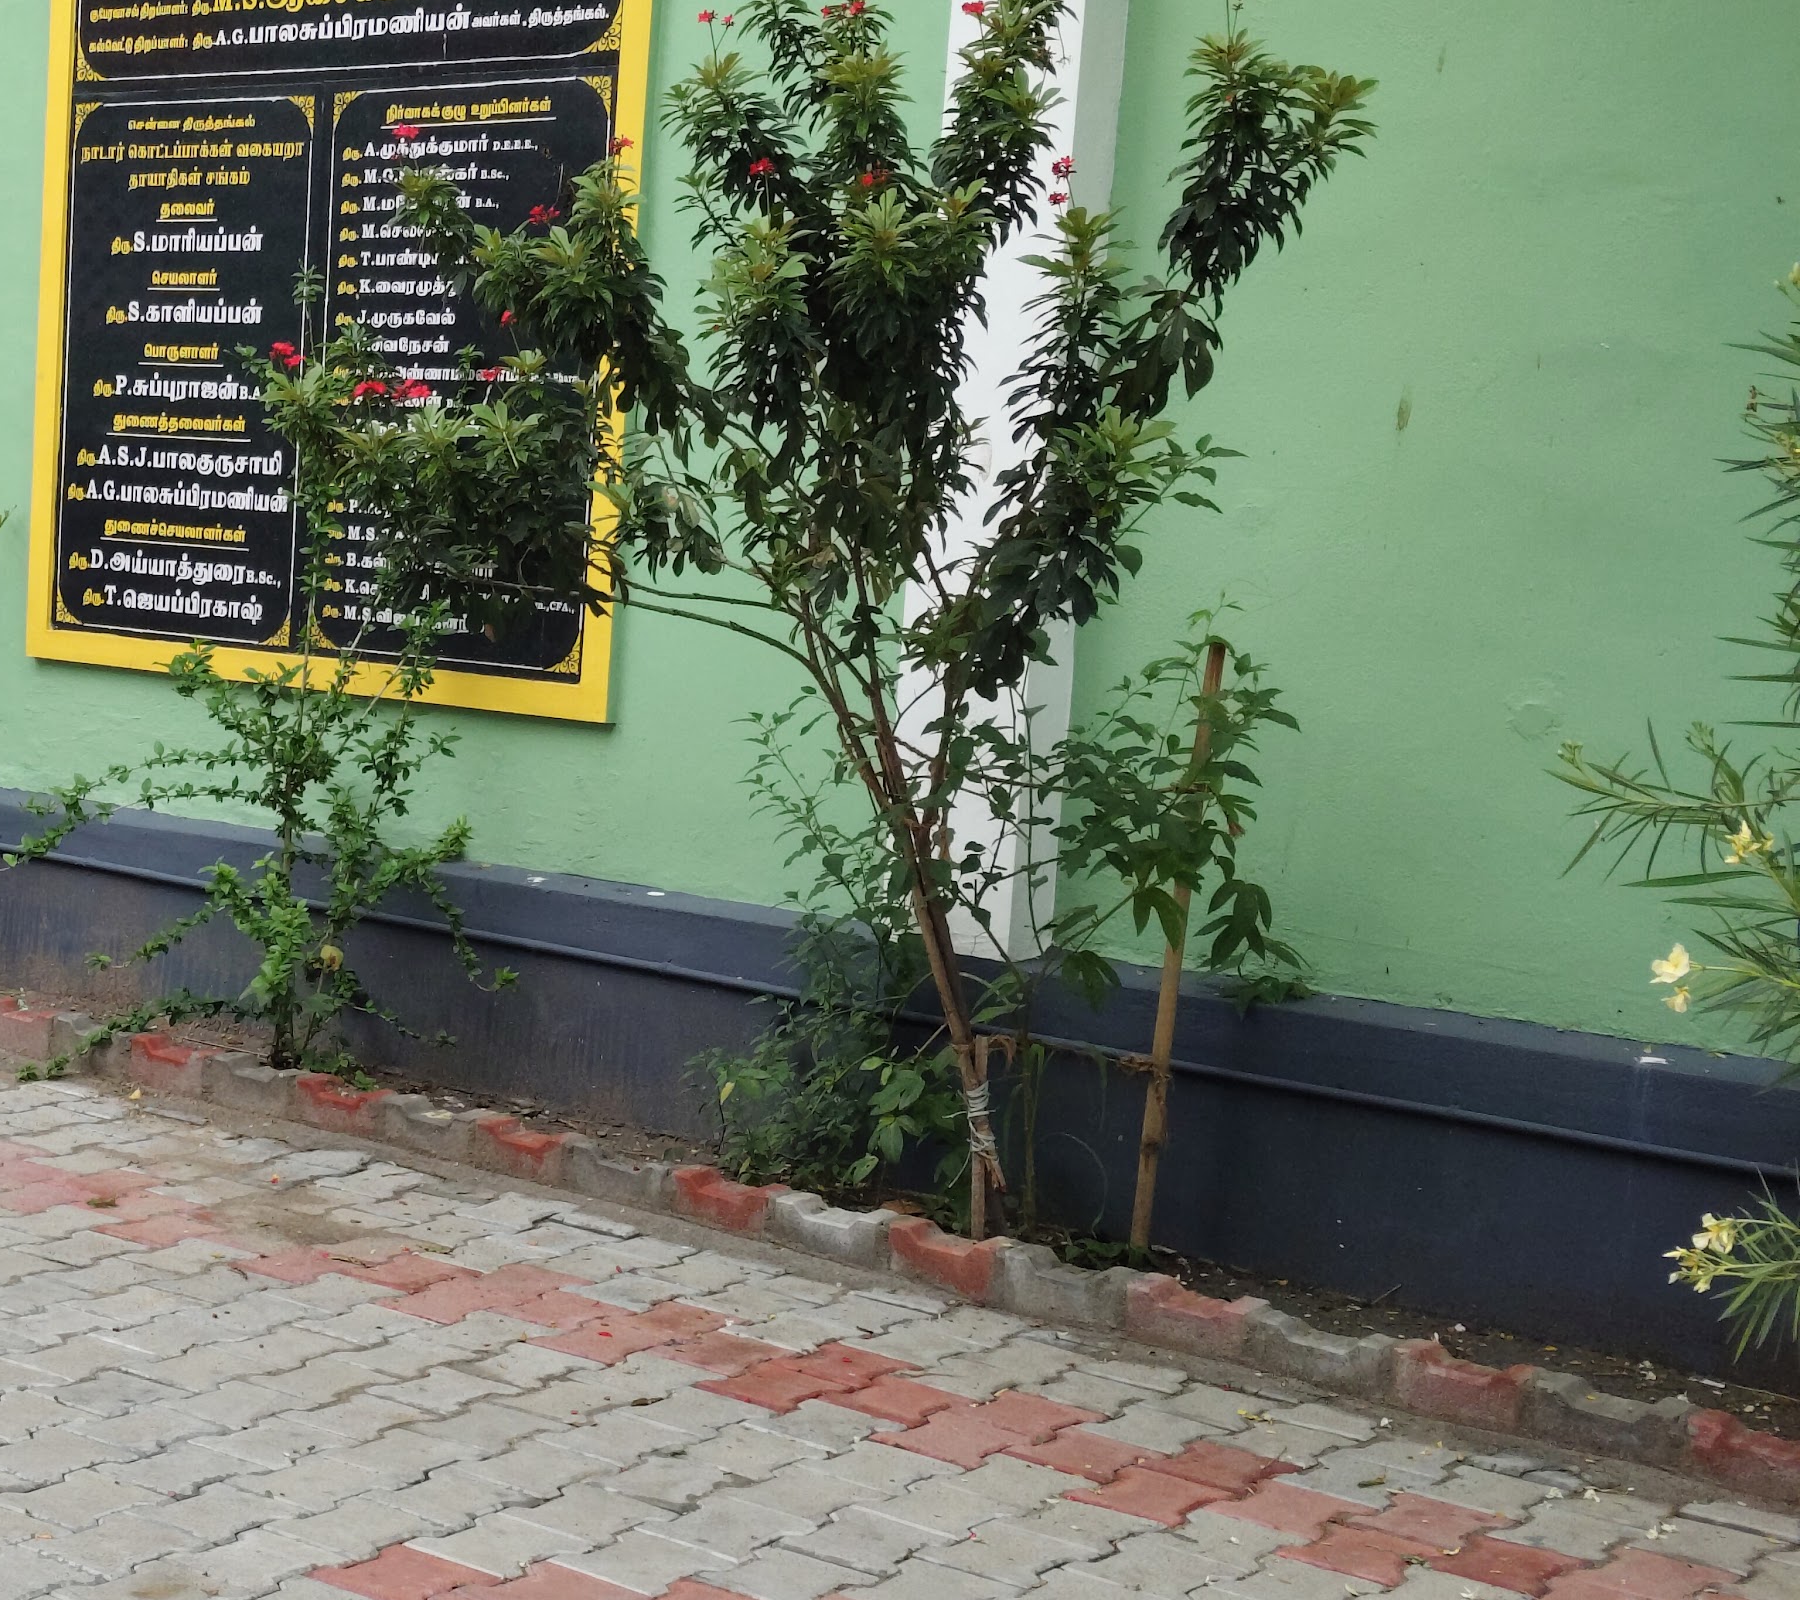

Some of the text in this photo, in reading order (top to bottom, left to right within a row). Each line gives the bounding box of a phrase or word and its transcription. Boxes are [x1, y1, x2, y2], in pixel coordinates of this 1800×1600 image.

[386, 96, 552, 124] நிர்வாகக்குழு உறுப்பினர்கள்
[128, 114, 255, 132] சென்னை திருத்தங்கல்
[81, 139, 304, 164] நாடார் கொட்டப்பாக்கன் வகையறா
[128, 165, 250, 191] தாயாதிகள் சங்கம்
[160, 199, 215, 219] தலைவர்
[152, 268, 218, 286] செயலாளர்
[144, 343, 219, 362] பொருளாளர்
[113, 412, 246, 433] துணைத்தலைவர்கள்
[104, 518, 246, 543] துணைச்செயலாளர்கள்
